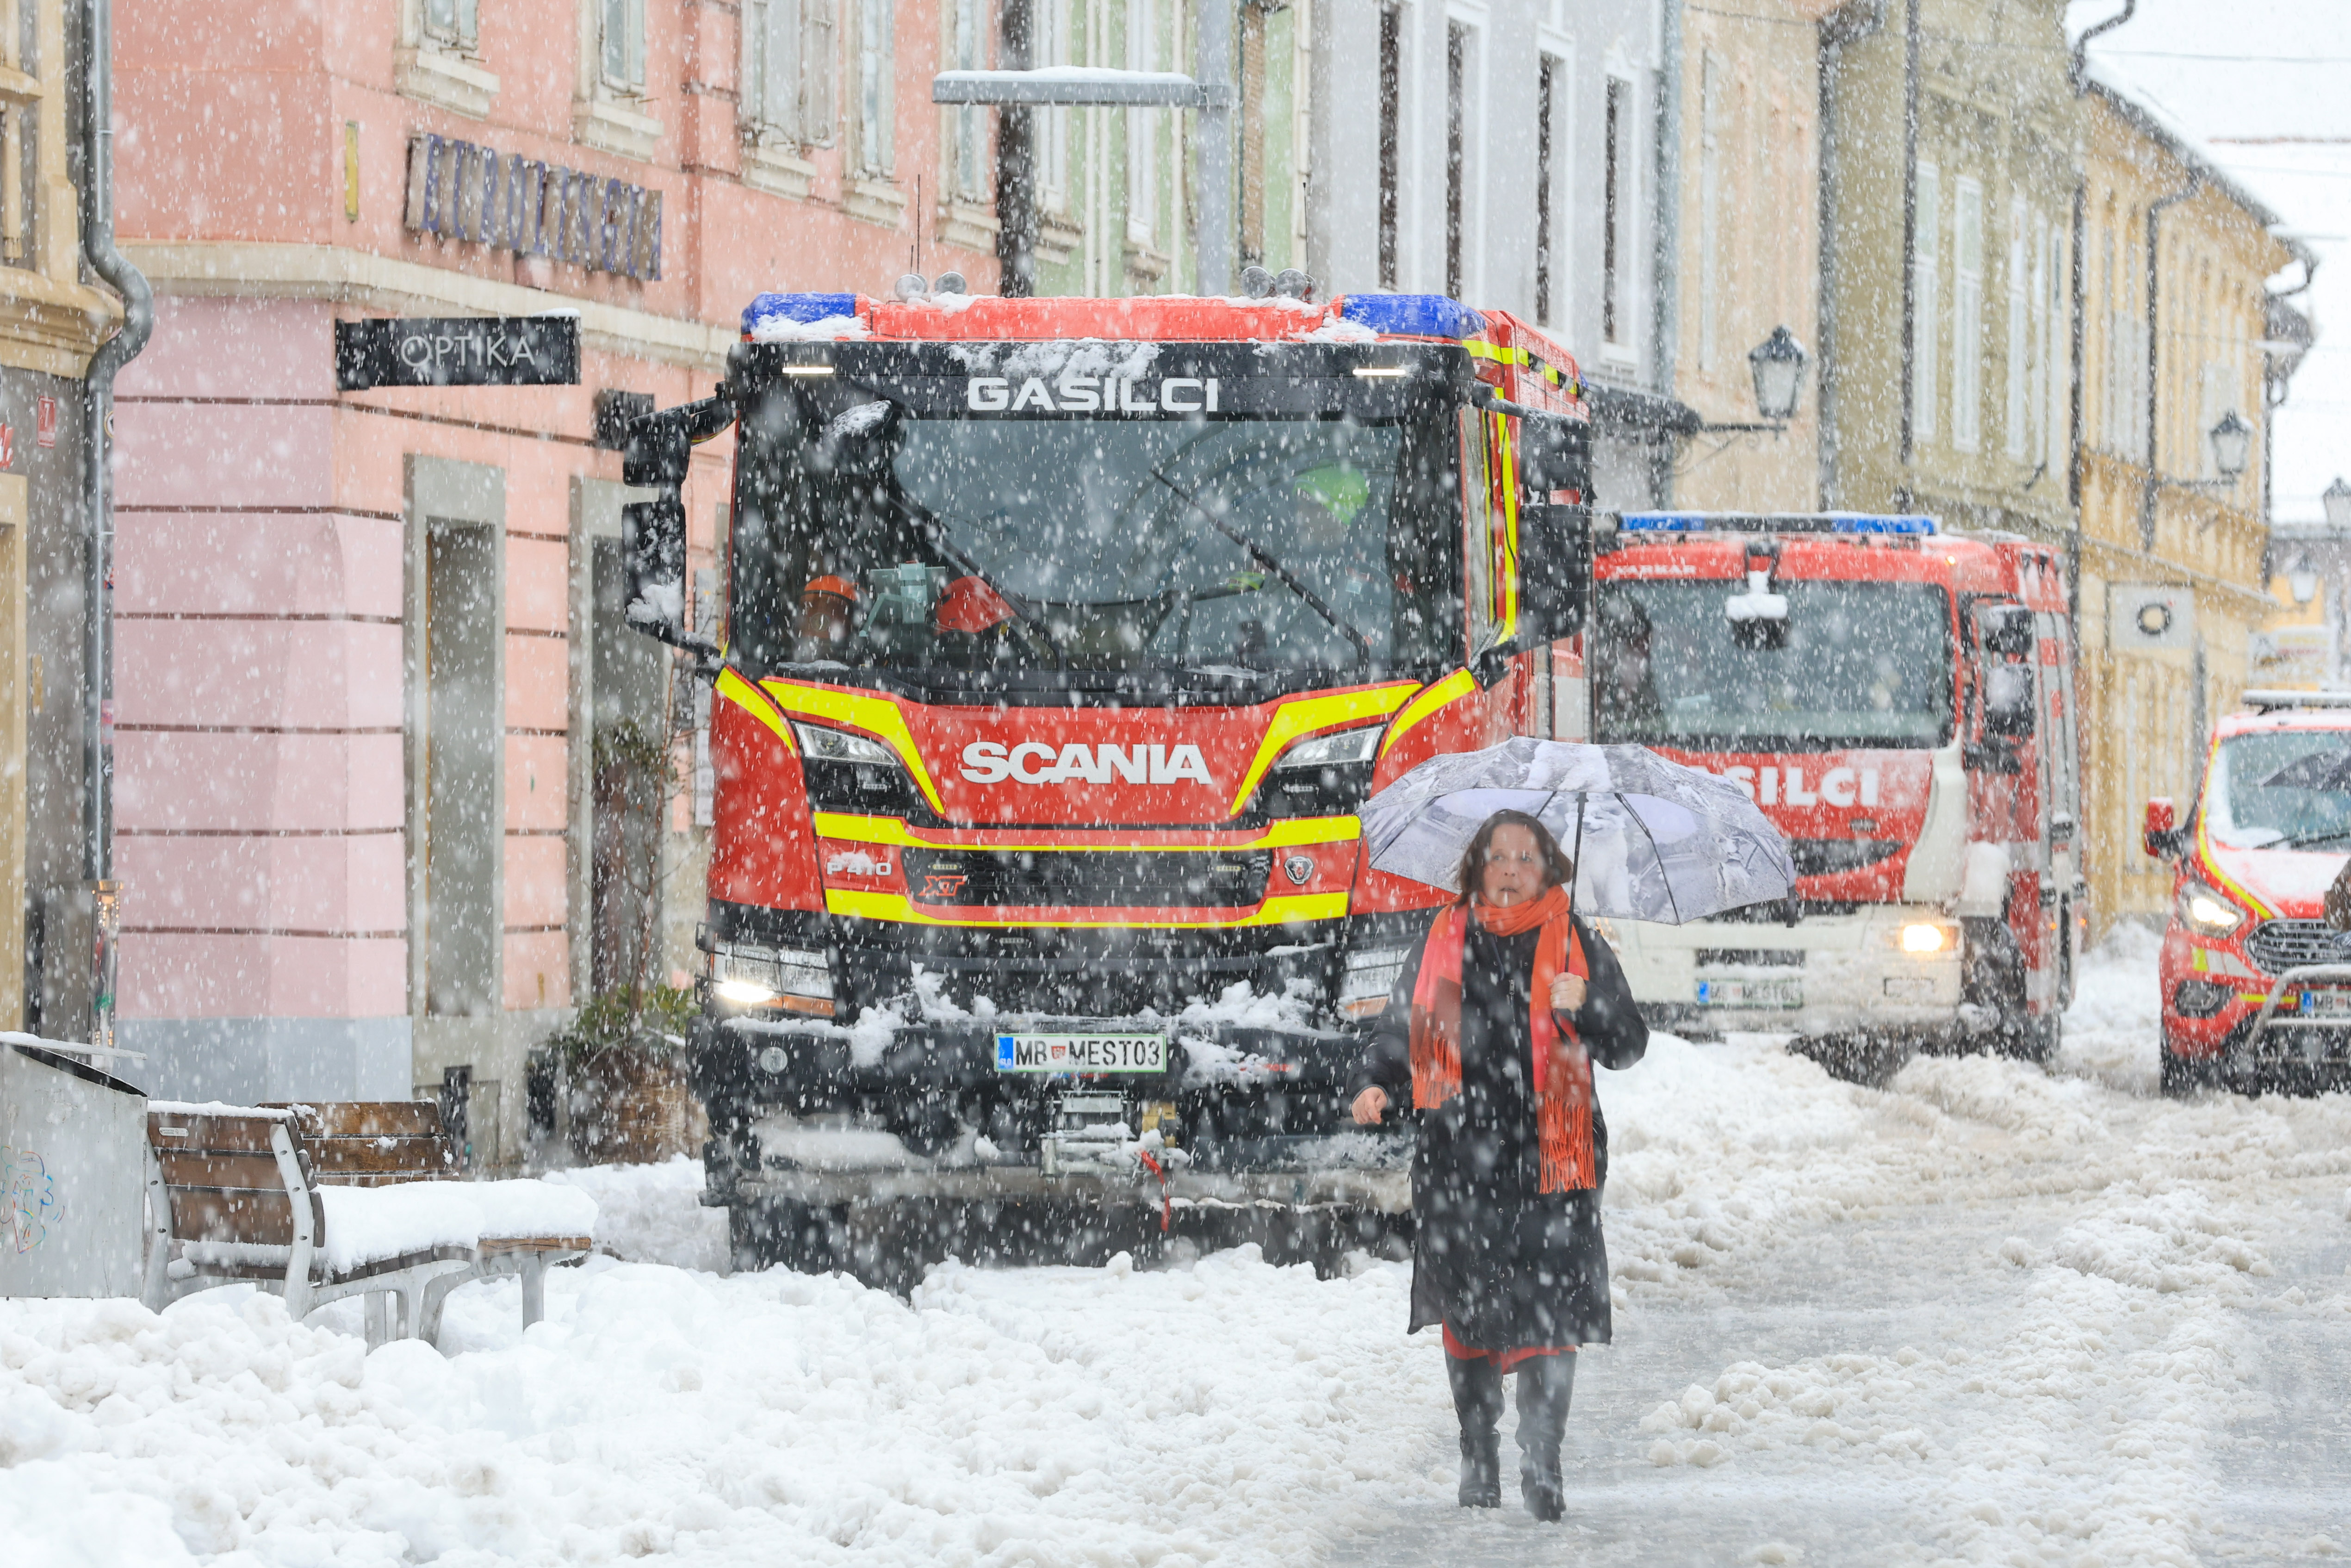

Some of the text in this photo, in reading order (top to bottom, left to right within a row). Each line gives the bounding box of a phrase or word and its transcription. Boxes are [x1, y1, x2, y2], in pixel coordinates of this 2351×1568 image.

[420, 133, 662, 280] EUROLINGUA
[401, 335, 535, 367] OPTIKA
[968, 377, 1218, 411] GASILCI
[961, 742, 1213, 784] SCANIA
[1688, 765, 1879, 807] SILCI
[918, 876, 965, 896] XT
[1016, 1040, 1160, 1066] MB MEST03
